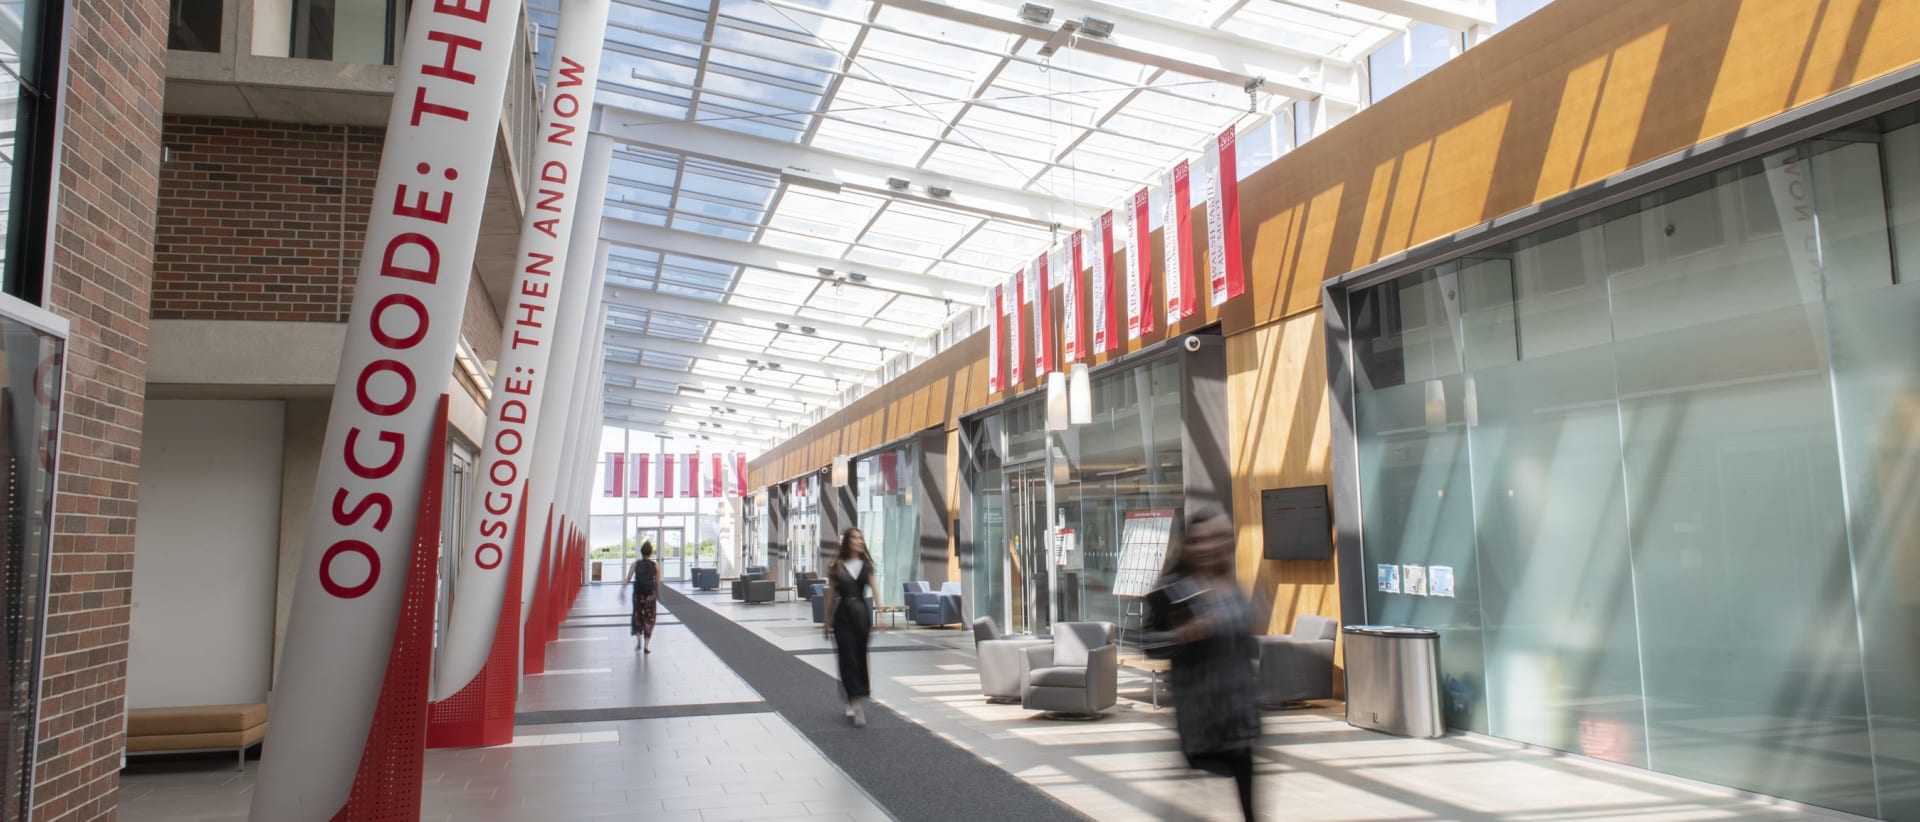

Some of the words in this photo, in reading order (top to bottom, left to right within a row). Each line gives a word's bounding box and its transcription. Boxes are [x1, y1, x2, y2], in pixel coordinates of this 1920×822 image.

[549, 57, 585, 146] NOW
[535, 161, 568, 239] AND
[1207, 176, 1215, 229] FAMILY
[1216, 202, 1224, 245] MOOT
[1209, 233, 1217, 279] WALSH
[319, 161, 458, 598] OSGOODE:
[410, 0, 491, 126] THE
[513, 253, 553, 349] THEN
[476, 365, 535, 570] OSGOODE:
